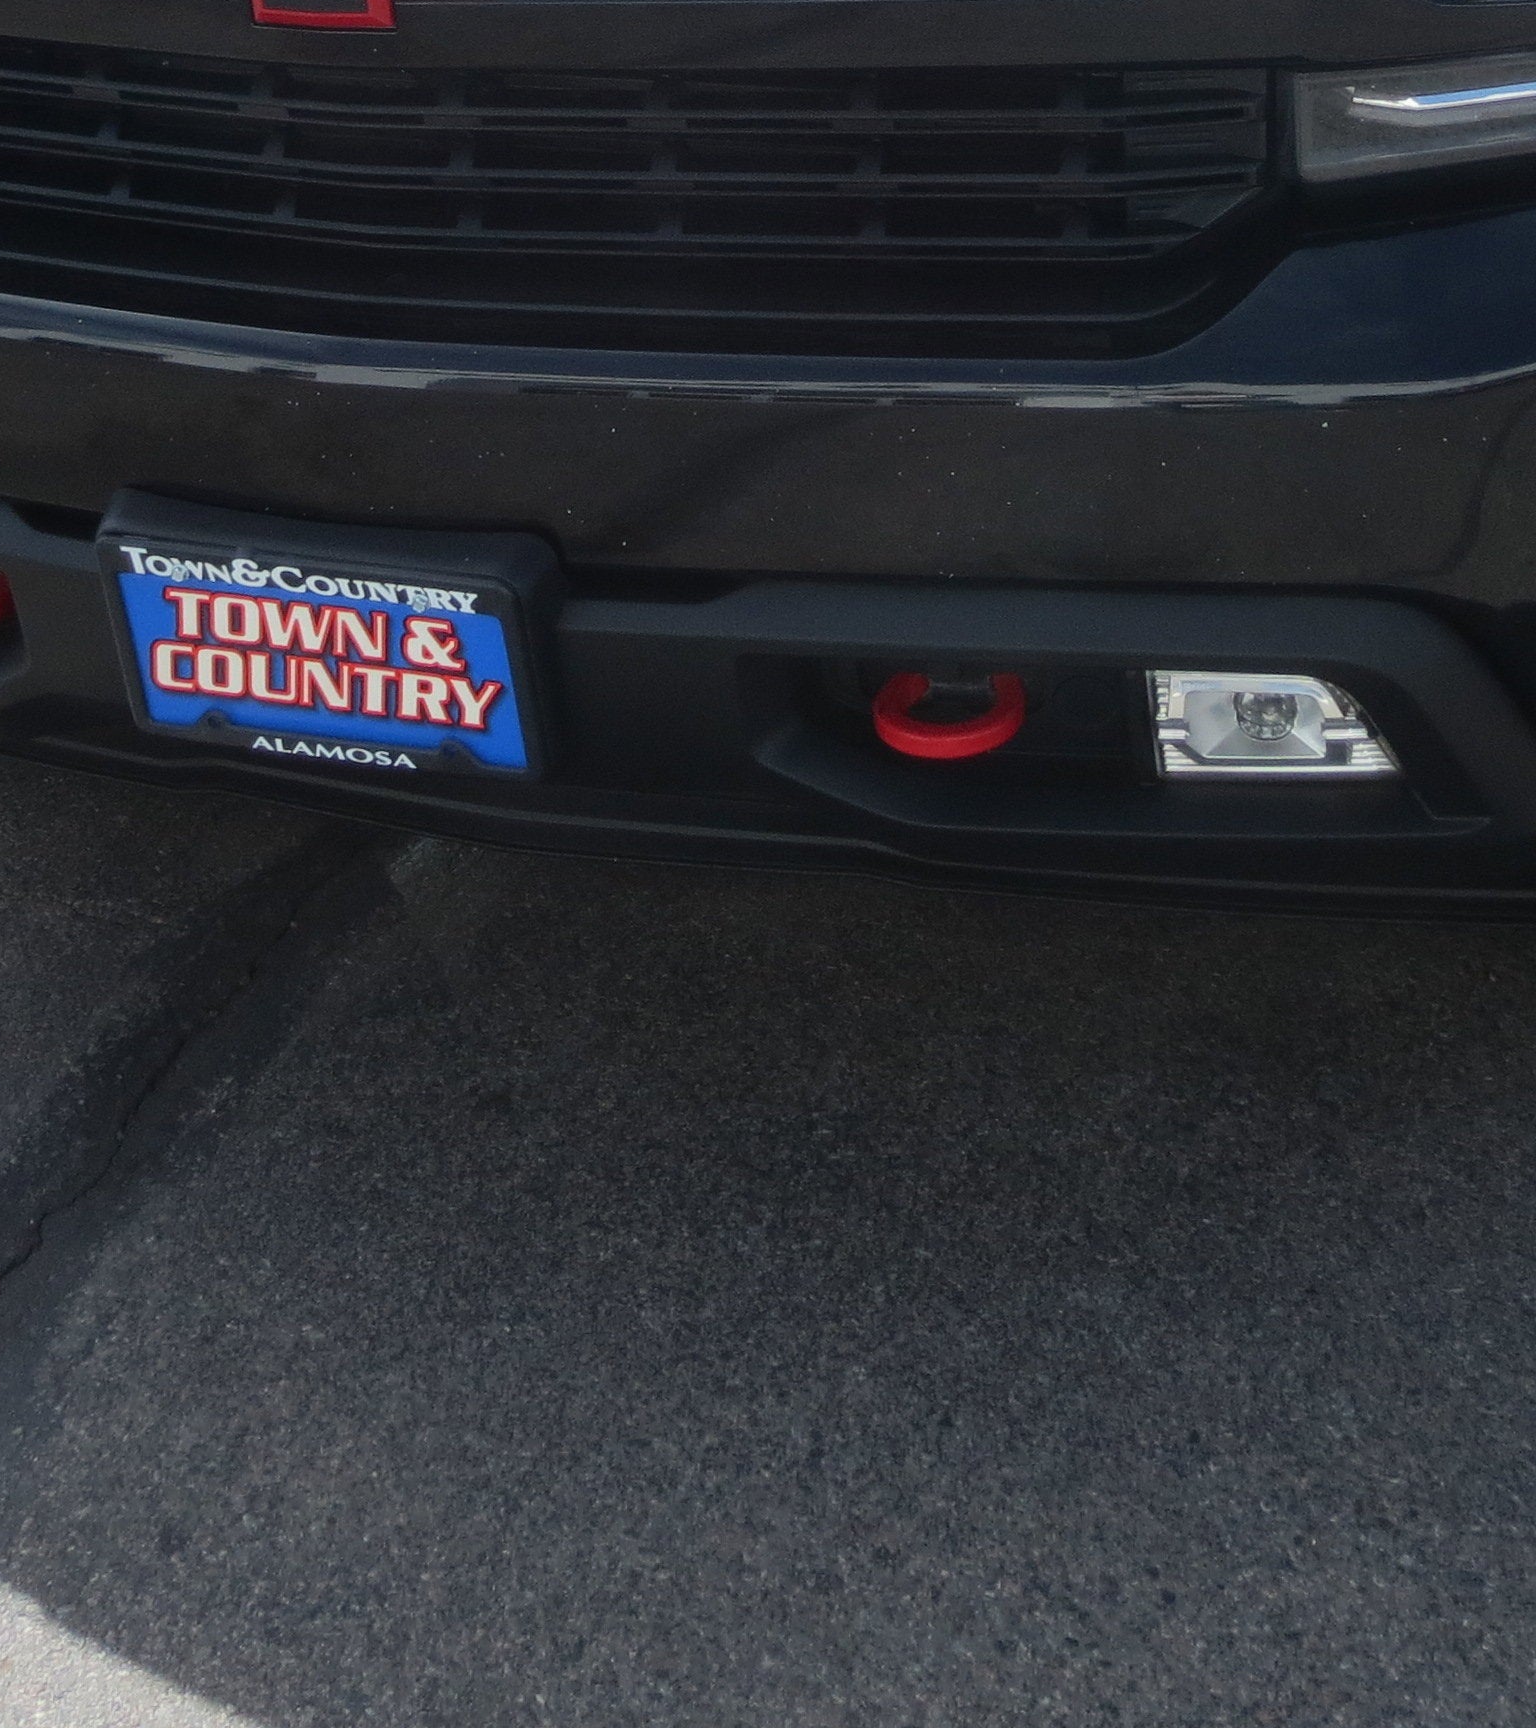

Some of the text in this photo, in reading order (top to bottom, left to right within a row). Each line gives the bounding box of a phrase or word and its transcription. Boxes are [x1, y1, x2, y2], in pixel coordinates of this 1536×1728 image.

[164, 586, 465, 672] TOWN &
[151, 638, 502, 730] COUNTRY
[252, 735, 417, 769] ALAMOSA
